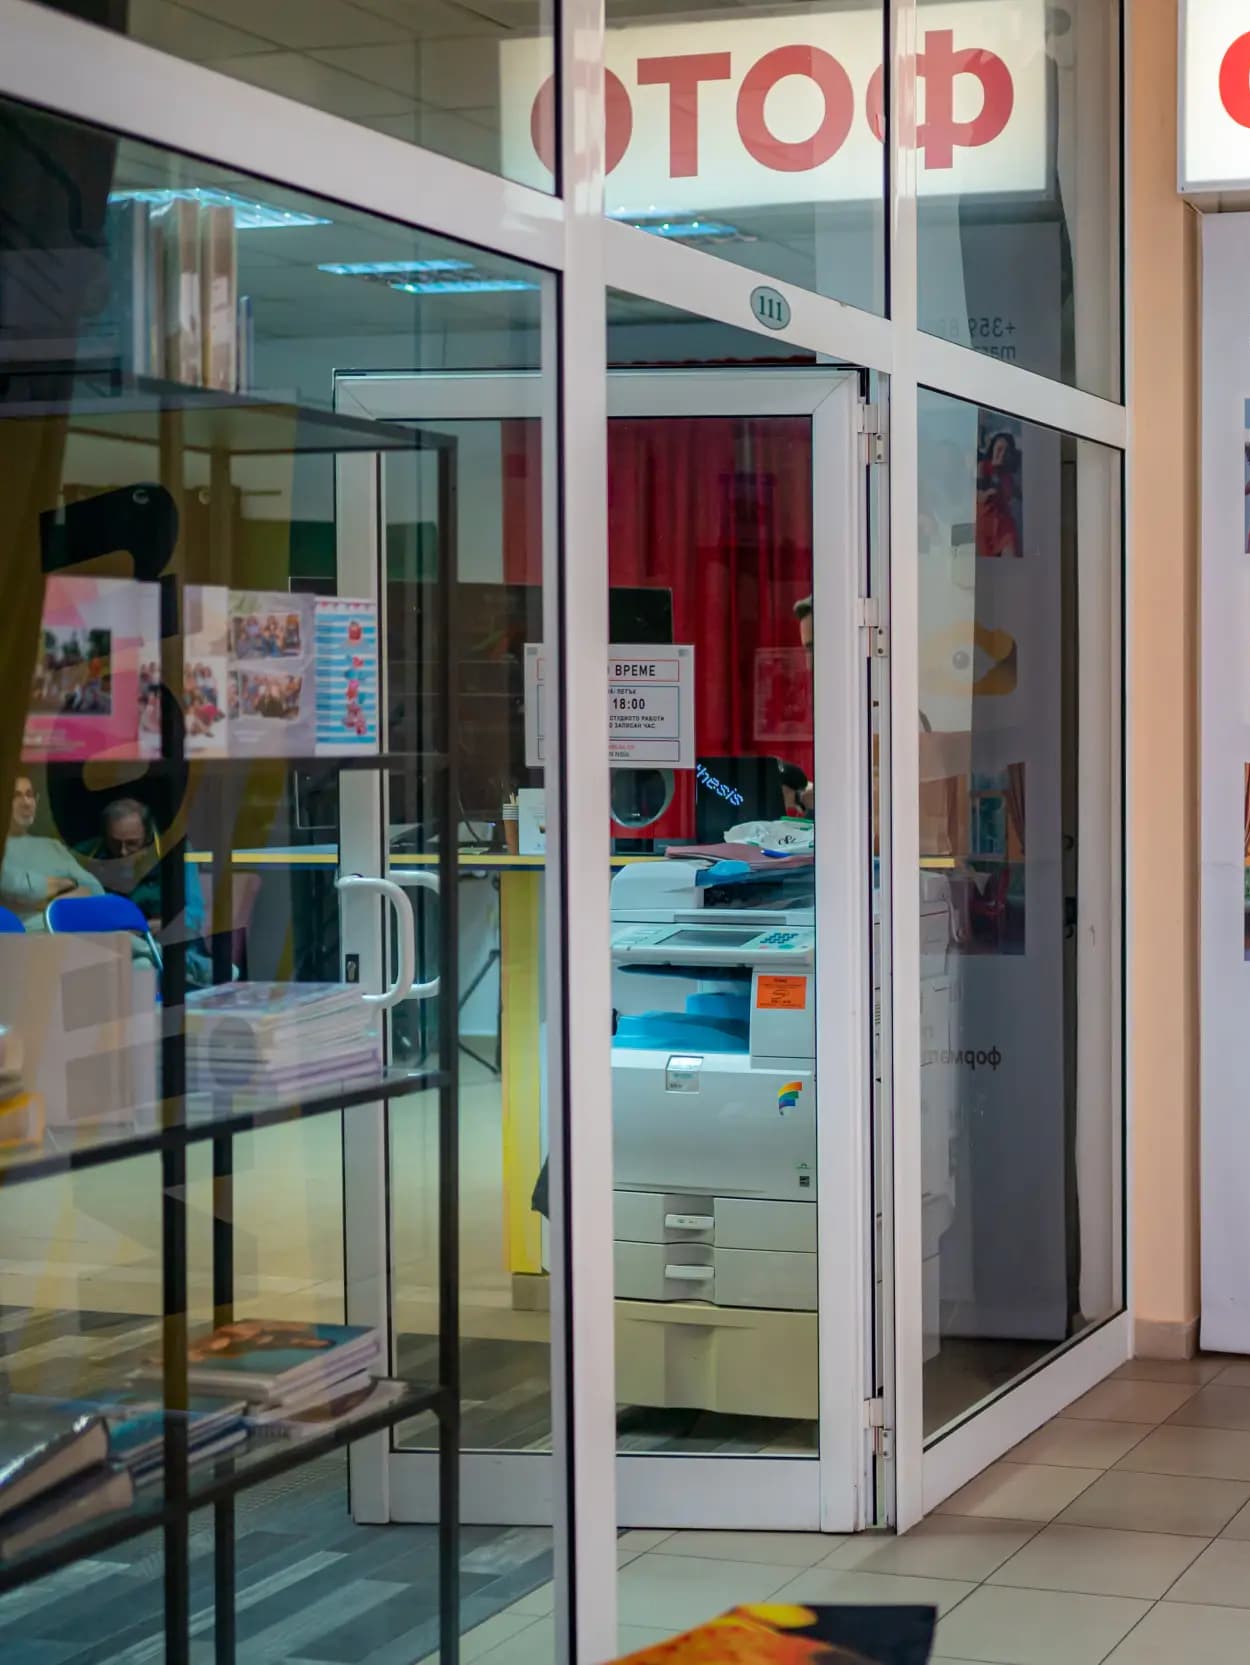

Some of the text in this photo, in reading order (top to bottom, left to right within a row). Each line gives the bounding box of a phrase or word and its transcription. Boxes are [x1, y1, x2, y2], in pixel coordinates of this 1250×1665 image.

[759, 295, 782, 322] 111
[615, 664, 656, 677] ВРЕМЕ
[613, 698, 645, 710] 18:00
